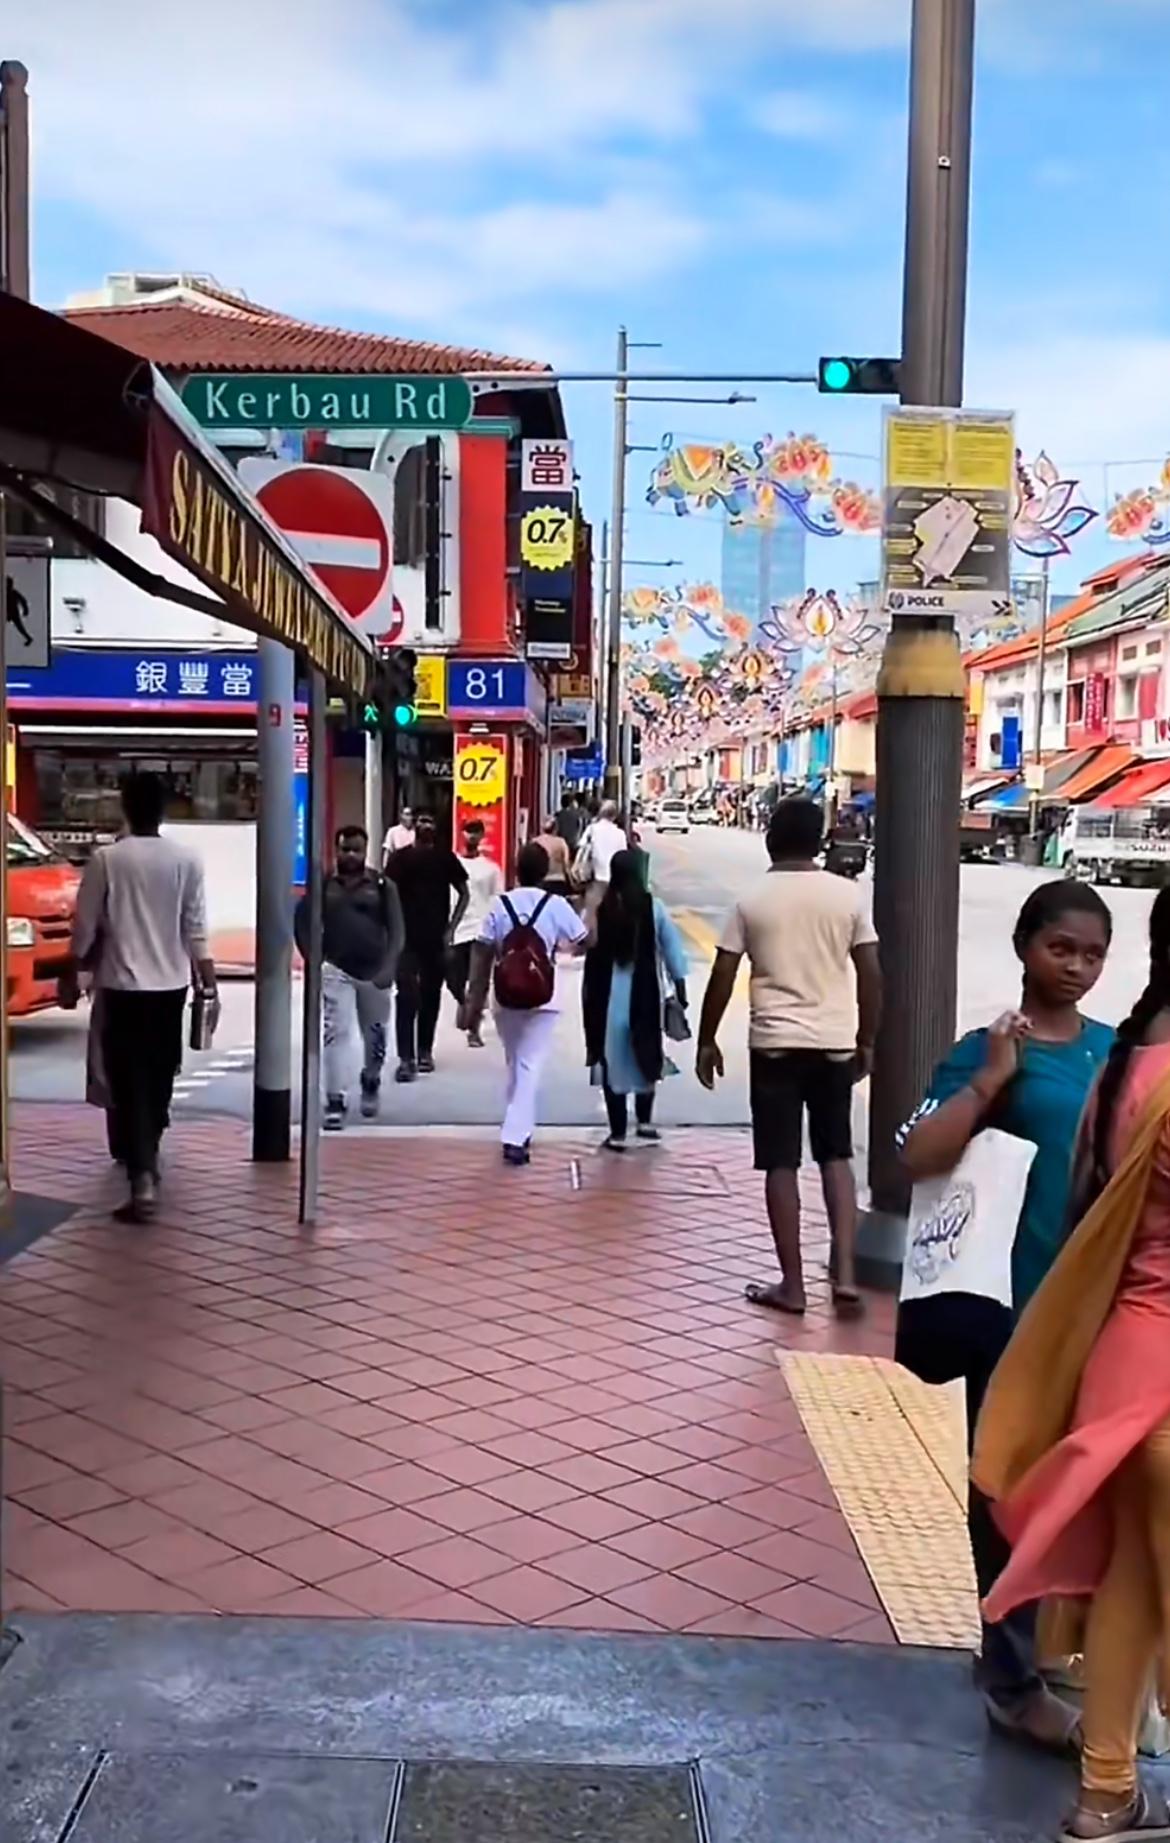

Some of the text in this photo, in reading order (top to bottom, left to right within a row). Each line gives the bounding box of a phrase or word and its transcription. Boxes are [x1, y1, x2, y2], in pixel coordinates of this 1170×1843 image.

[206, 381, 446, 419] Kerbau Rd
[528, 445, 567, 485] 當
[907, 595, 944, 607] POLICE
[135, 660, 253, 696] 銀豐當
[465, 667, 504, 699] 81
